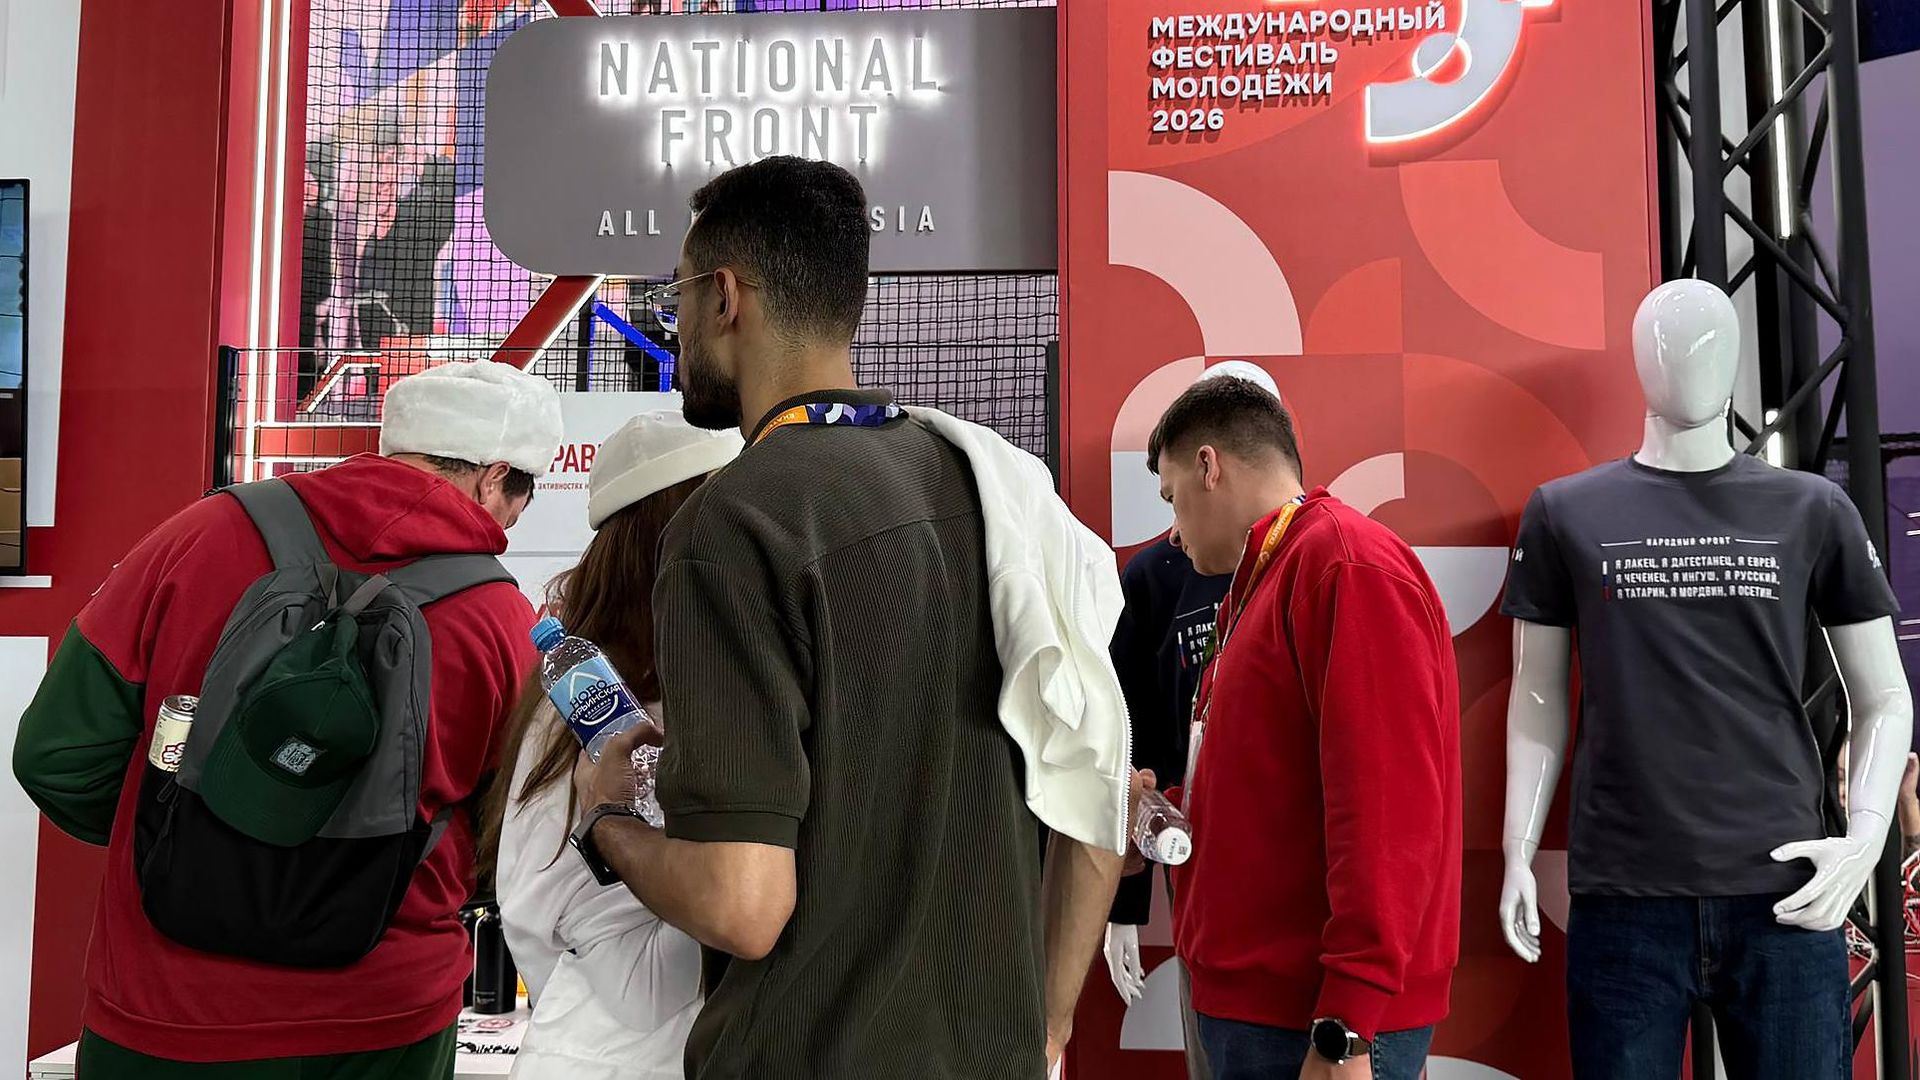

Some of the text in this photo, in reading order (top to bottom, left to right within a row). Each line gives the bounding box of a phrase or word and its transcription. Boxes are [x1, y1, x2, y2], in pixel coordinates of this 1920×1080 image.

[1152, 2, 1446, 39] МЕЖДУНАРОДНЫЙ
[599, 37, 940, 95] NATIONAL
[1152, 42, 1338, 68] ФЕСТИВАЛЬ
[1152, 69, 1332, 99] МОЛОДЁЖИ
[1152, 108, 1224, 131] 2026
[661, 106, 877, 162] FRONT
[598, 206, 935, 235] ALL SIA
[1646, 536, 1731, 546] НАРОДНЫЙ ФРОНТ
[1615, 559, 1622, 569] Я
[1661, 557, 1669, 568] Я
[1737, 556, 1745, 566] Я
[1615, 573, 1622, 584] Я
[1672, 571, 1680, 582] Я
[1724, 570, 1732, 580] Я
[1616, 588, 1623, 599] Я
[1670, 587, 1677, 597] Я
[1728, 585, 1736, 596] Я
[1187, 622, 1216, 637] Я ЛАК
[570, 680, 607, 709] НОВО
[570, 684, 621, 723] КУРЬИНСКАЯ
